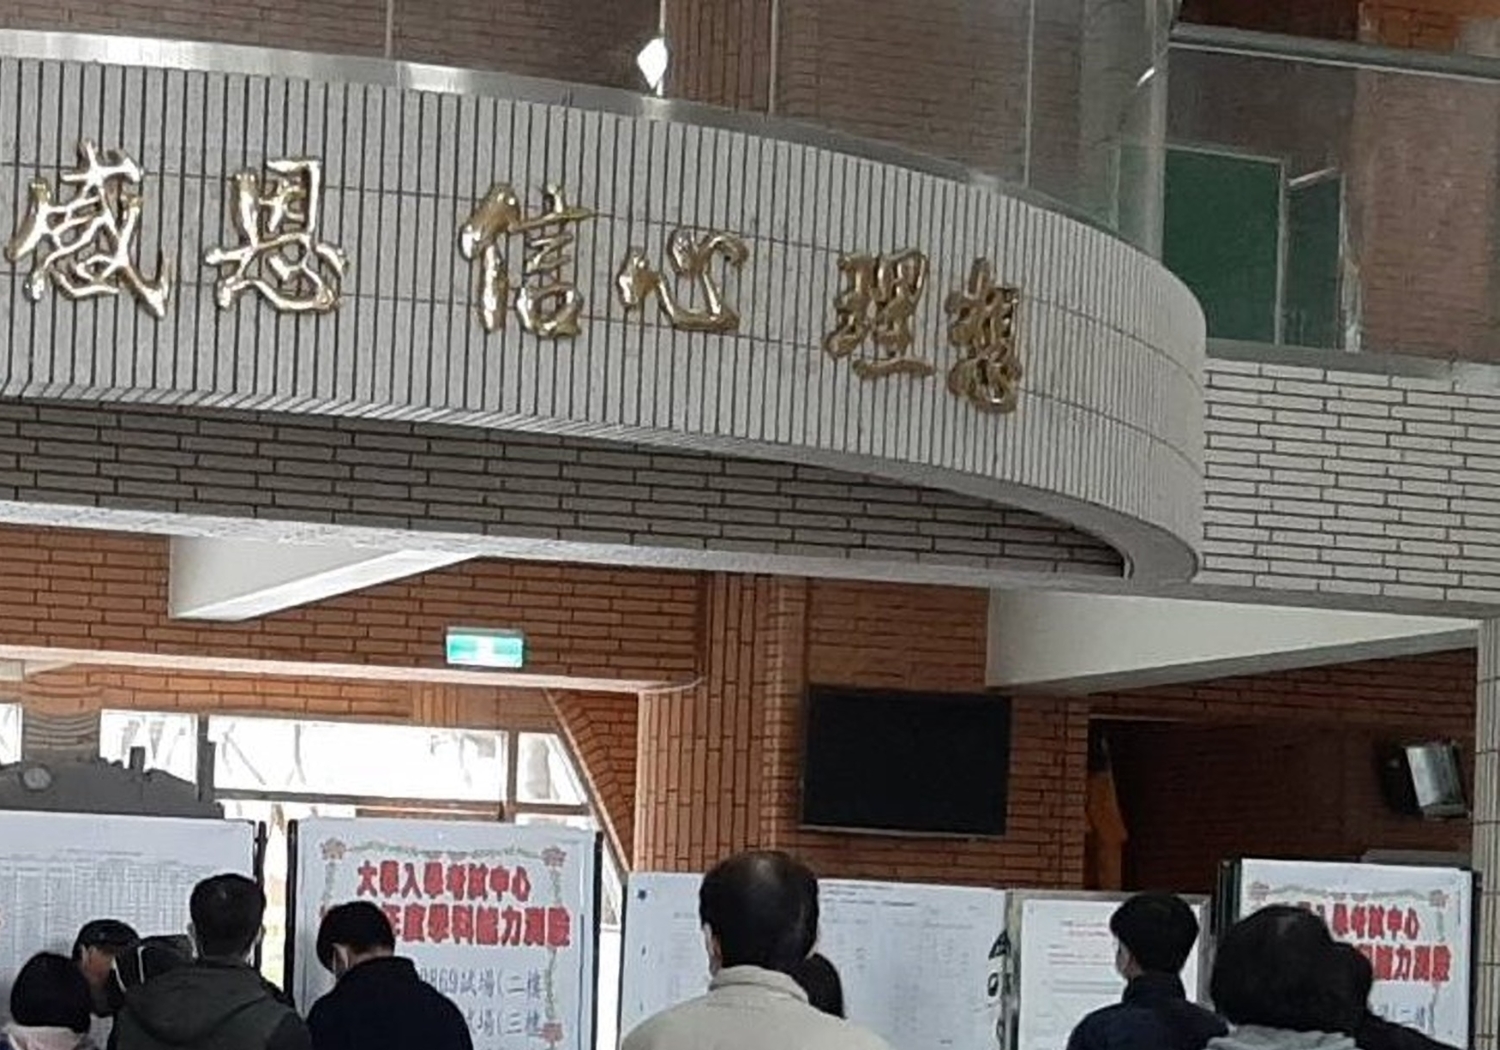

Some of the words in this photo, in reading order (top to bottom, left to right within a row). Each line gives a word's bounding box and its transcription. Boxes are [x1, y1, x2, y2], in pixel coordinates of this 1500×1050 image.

[5, 139, 350, 319] 感恩
[458, 180, 750, 340] 信心
[824, 247, 1024, 413] 理想
[356, 860, 531, 902] 大學入學考試中心
